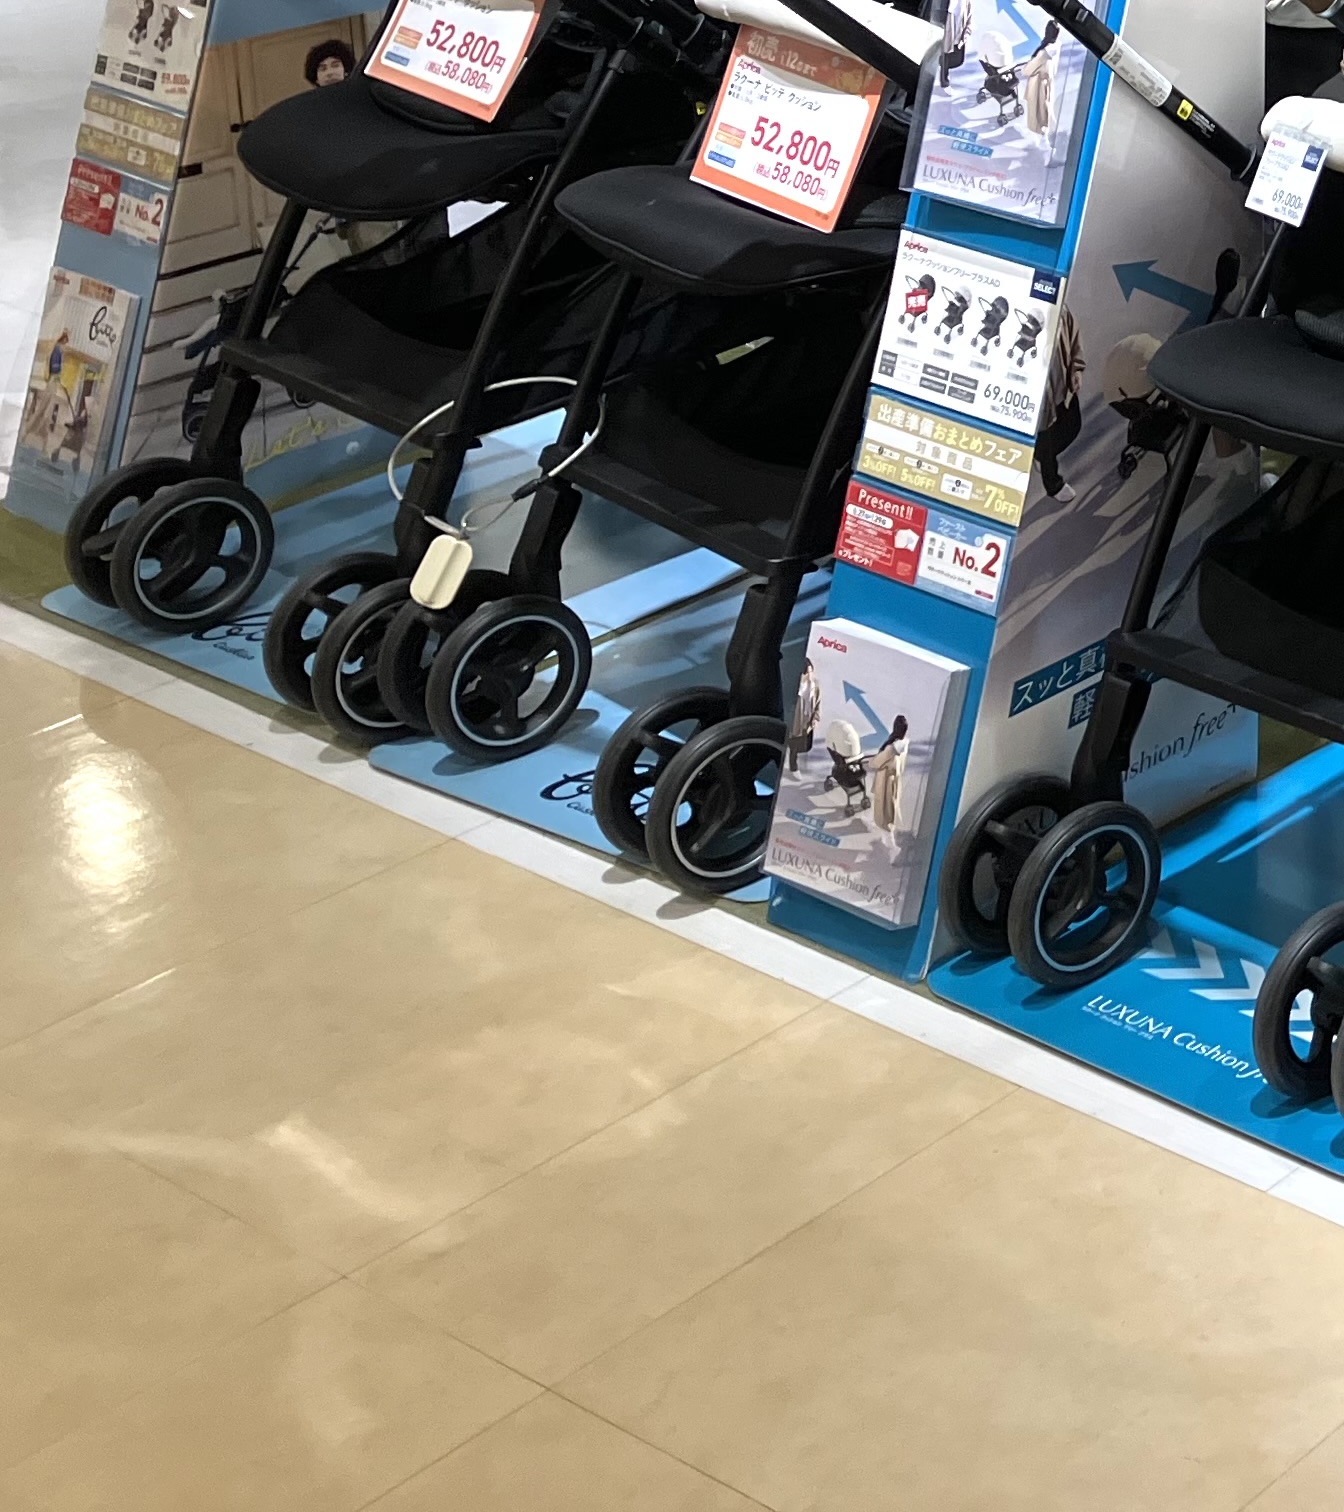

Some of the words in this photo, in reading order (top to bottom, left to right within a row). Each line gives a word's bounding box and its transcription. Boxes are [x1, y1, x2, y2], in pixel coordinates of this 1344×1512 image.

[426, 19, 506, 74] 52,800円
[747, 31, 780, 63] 初売
[734, 71, 762, 90] ラクーナ
[765, 81, 786, 98] ビッテ
[788, 92, 822, 112] クッション
[751, 116, 841, 178] 52,800円
[922, 163, 975, 189] LUXUNA
[979, 178, 1025, 200] Cushion
[904, 240, 929, 254] Aprica
[1033, 281, 1056, 295] SELECT
[984, 383, 1036, 412] 69,000円
[877, 403, 1022, 465] 出産準備おまとめフェア
[916, 440, 973, 471] 対象商品
[857, 488, 913, 520] Present!!
[953, 541, 1001, 579] No.2
[817, 635, 848, 653] Aprica
[772, 847, 823, 878] LUXUNA
[825, 868, 870, 896] Cushion
[1086, 995, 1173, 1040] LUXUNA
[1173, 1031, 1249, 1078] Cushion
